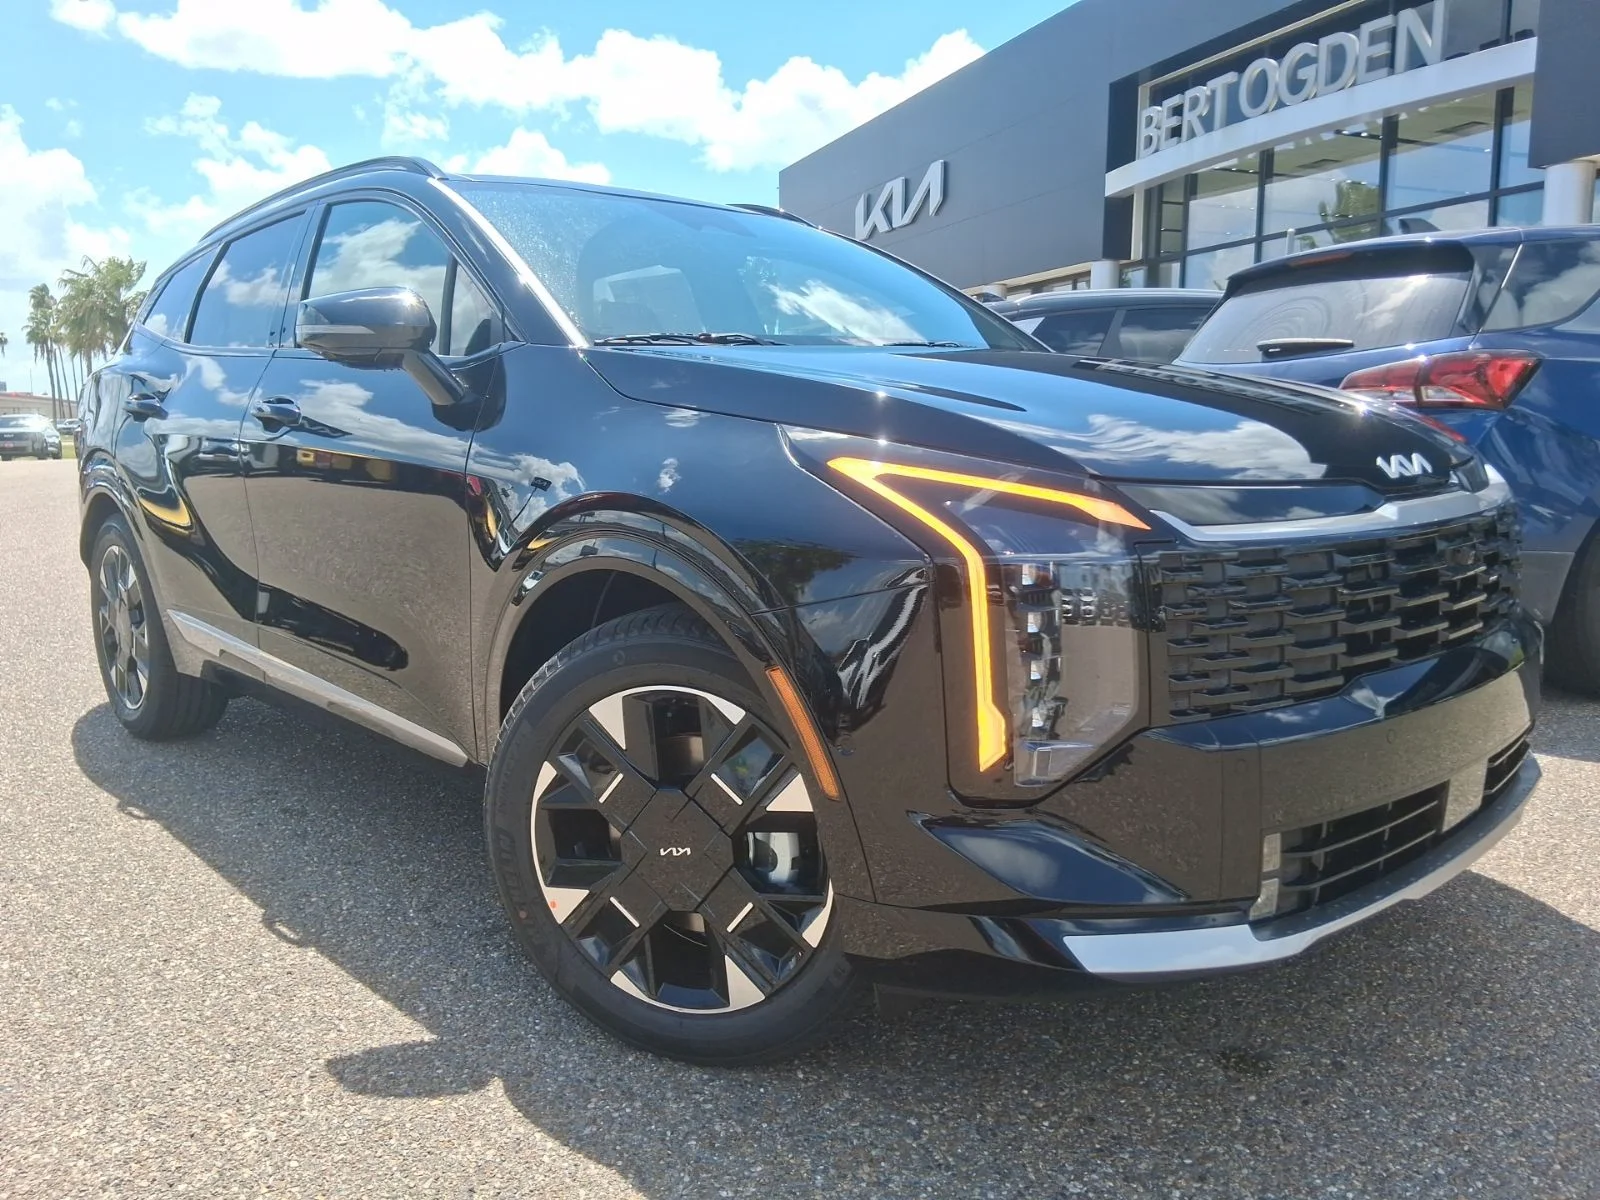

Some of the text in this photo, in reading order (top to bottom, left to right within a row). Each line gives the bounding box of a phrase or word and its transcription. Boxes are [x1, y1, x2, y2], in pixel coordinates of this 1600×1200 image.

[1138, 0, 1445, 160] BERT OGDEN
[855, 160, 944, 241] KIA
[1376, 453, 1433, 479] KIA
